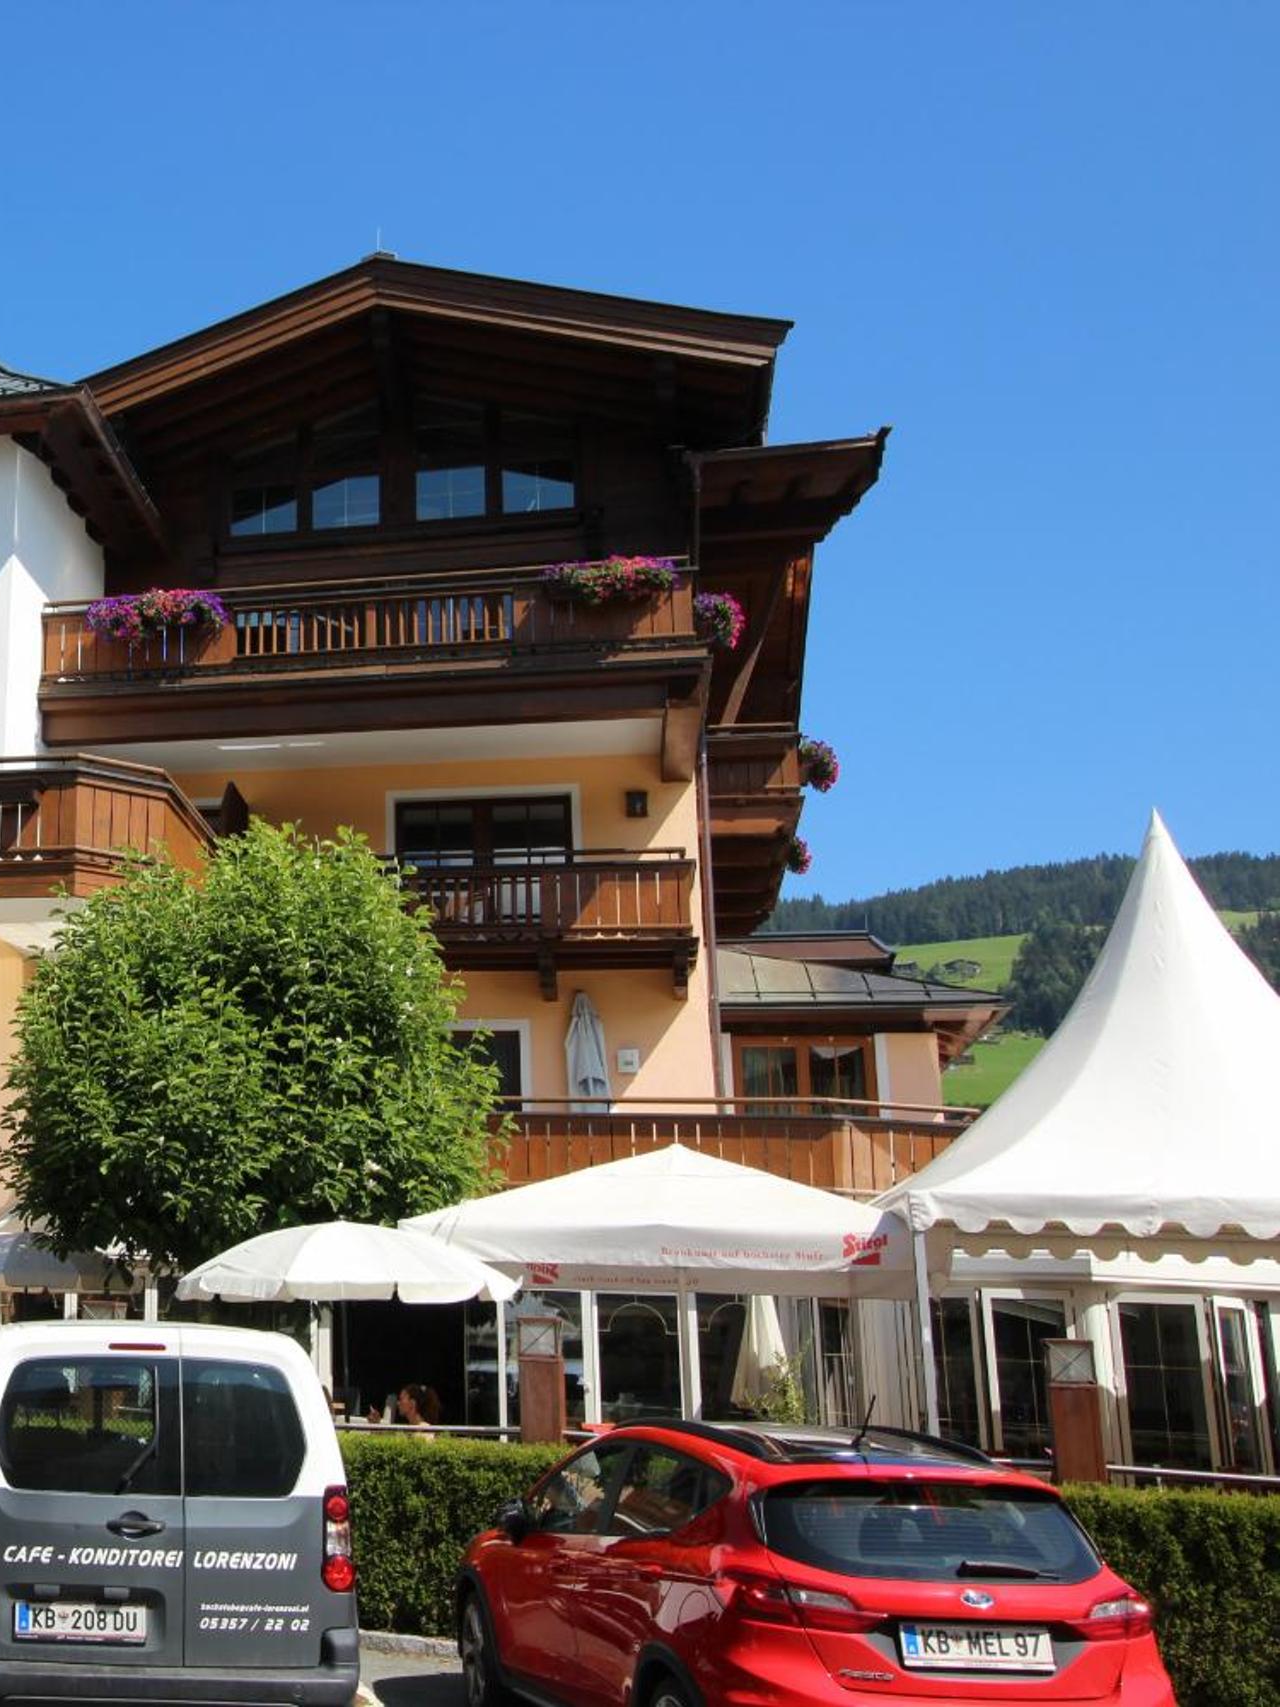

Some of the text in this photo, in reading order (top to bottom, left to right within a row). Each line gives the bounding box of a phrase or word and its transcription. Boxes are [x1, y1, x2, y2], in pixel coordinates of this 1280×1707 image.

[3, 1546, 54, 1564] CAFE
[69, 1548, 184, 1567] KONDITOREI
[193, 1551, 298, 1571] LORENZONI
[31, 1608, 138, 1632] KB 208 DU
[199, 1617, 248, 1630] 05357
[264, 1618, 284, 1631] 22
[291, 1618, 310, 1631] 02
[921, 1629, 1041, 1657] KB MEL 97
